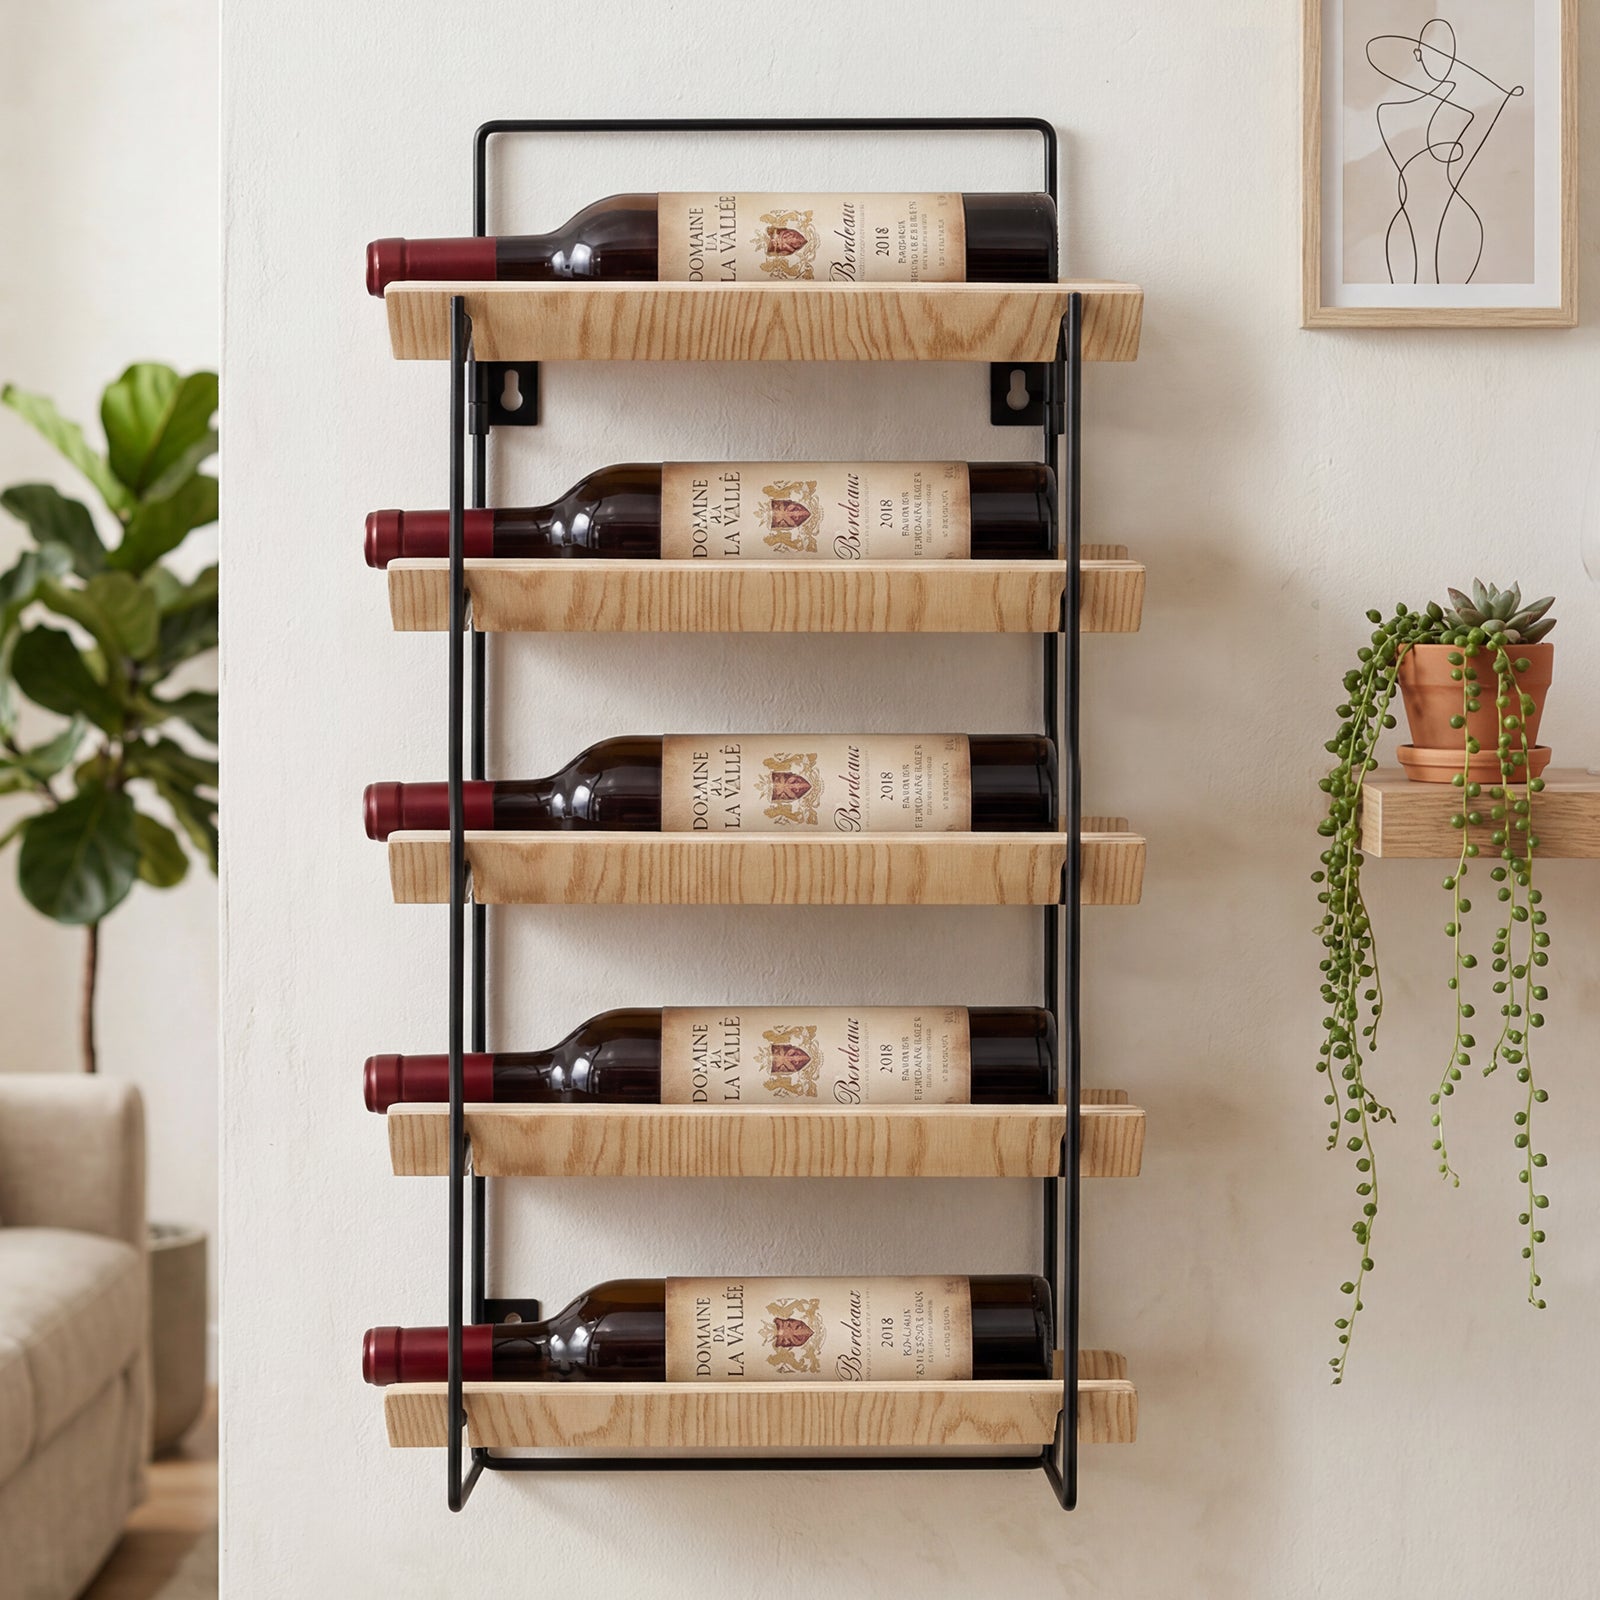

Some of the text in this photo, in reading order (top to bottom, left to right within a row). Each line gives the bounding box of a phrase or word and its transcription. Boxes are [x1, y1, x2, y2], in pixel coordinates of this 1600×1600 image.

[689, 208, 704, 281] DOMAINE
[714, 196, 736, 281] LA VALLÉE
[875, 227, 889, 256] 2018
[880, 500, 893, 528] 2018
[724, 531, 740, 556] LA
[880, 772, 893, 800] 2018
[724, 803, 740, 828] LA
[880, 1045, 893, 1073] 2018
[724, 1076, 740, 1101] LA
[696, 1297, 711, 1376] DOMAINE
[722, 1284, 744, 1376] LA VALLÉE
[835, 1290, 862, 1381] Bordeaux
[881, 1317, 894, 1348] 2018
